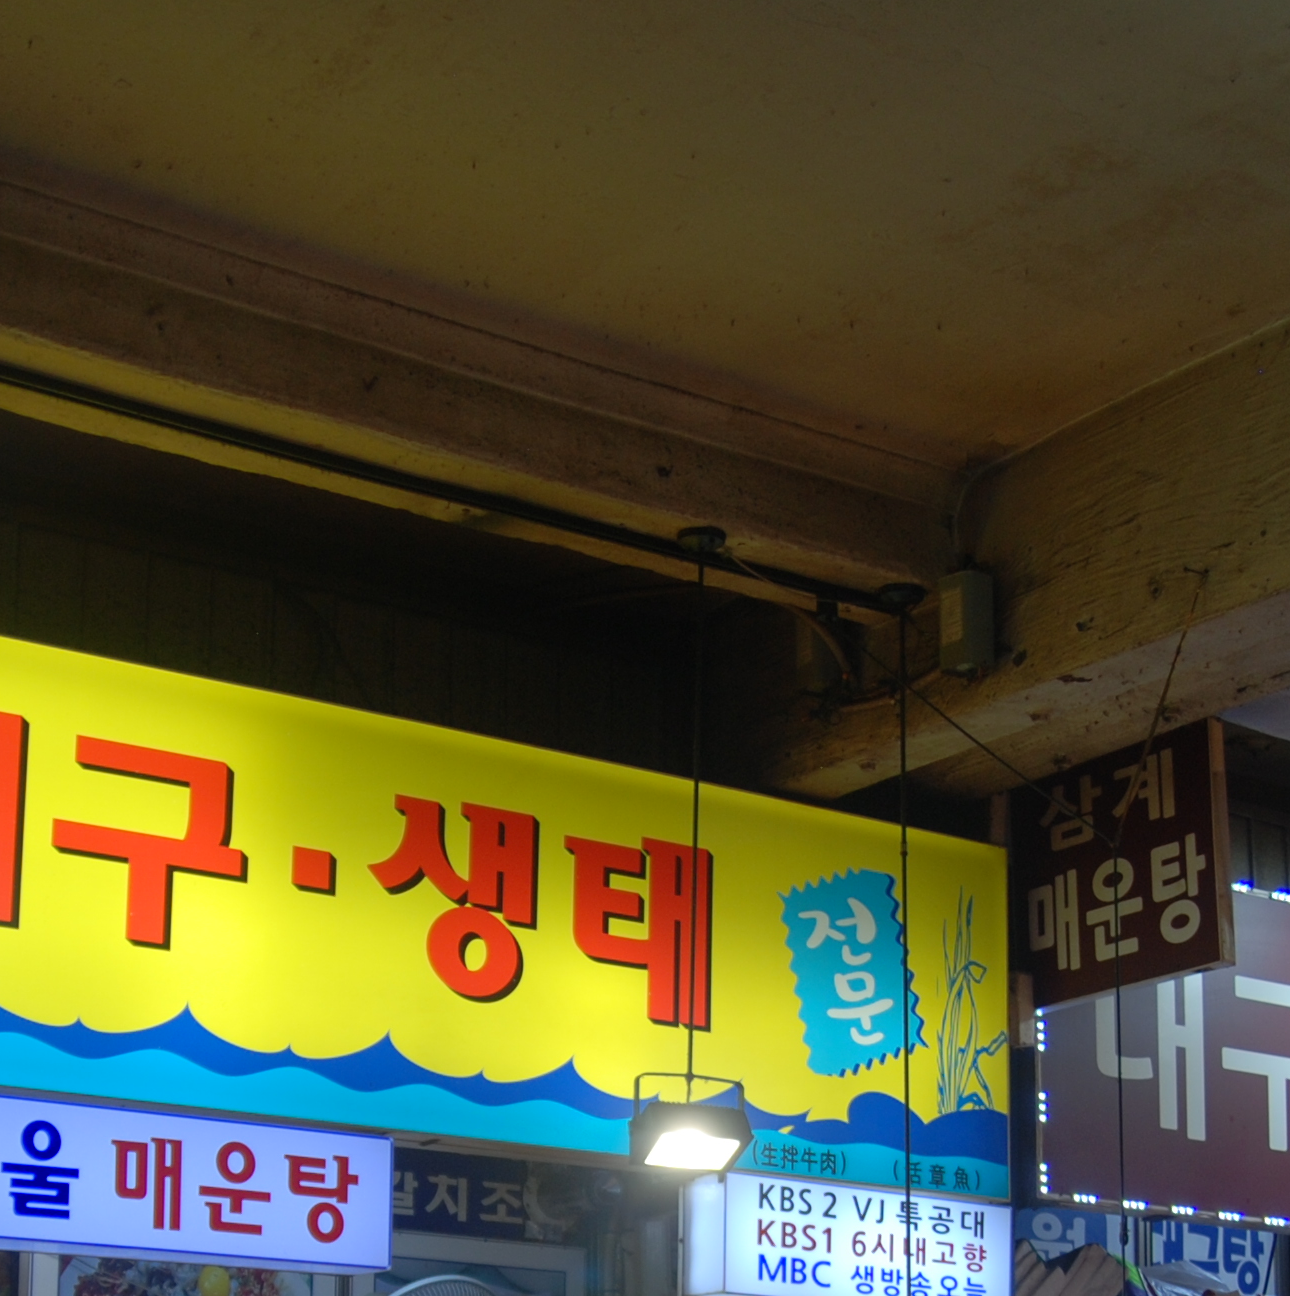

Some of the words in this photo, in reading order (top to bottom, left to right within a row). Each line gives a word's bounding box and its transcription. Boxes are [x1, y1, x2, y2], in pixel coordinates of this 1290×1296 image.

[1040, 749, 1175, 851] 삼계
[1027, 832, 1206, 970] 매운탕
[797, 898, 893, 1046] 전문
[111, 1137, 360, 1243] 매운탕
[757, 1219, 833, 1253] KBS1
[759, 1183, 812, 1215] KBS
[823, 1192, 837, 1219] 2
[853, 1195, 885, 1224] VJ
[896, 1200, 986, 1239] 특공대
[758, 1254, 832, 1288] MBC
